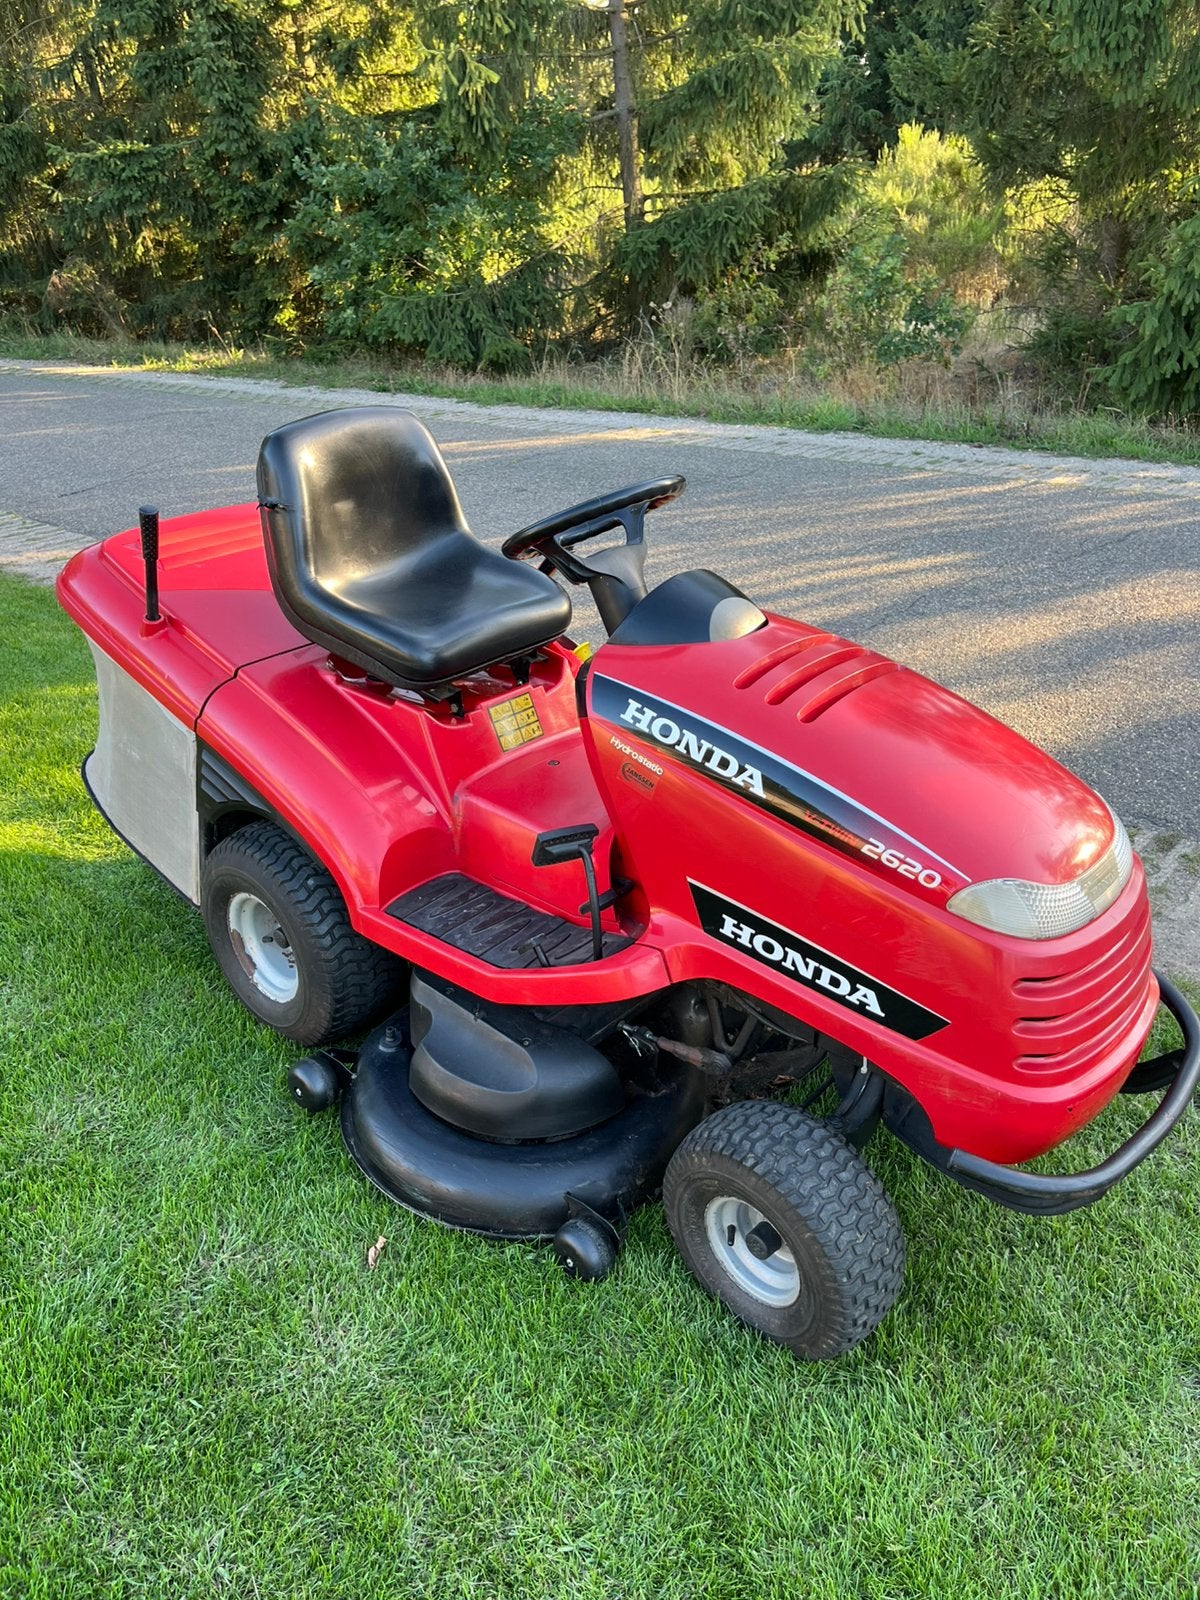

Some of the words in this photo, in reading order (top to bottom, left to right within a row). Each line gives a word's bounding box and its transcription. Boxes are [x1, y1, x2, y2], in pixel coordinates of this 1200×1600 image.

[609, 736, 663, 775] Hydrostatic
[620, 698, 766, 798] HONDA
[626, 768, 655, 789] JANSSEN
[861, 838, 942, 889] 2620
[719, 914, 885, 1018] HONDA
